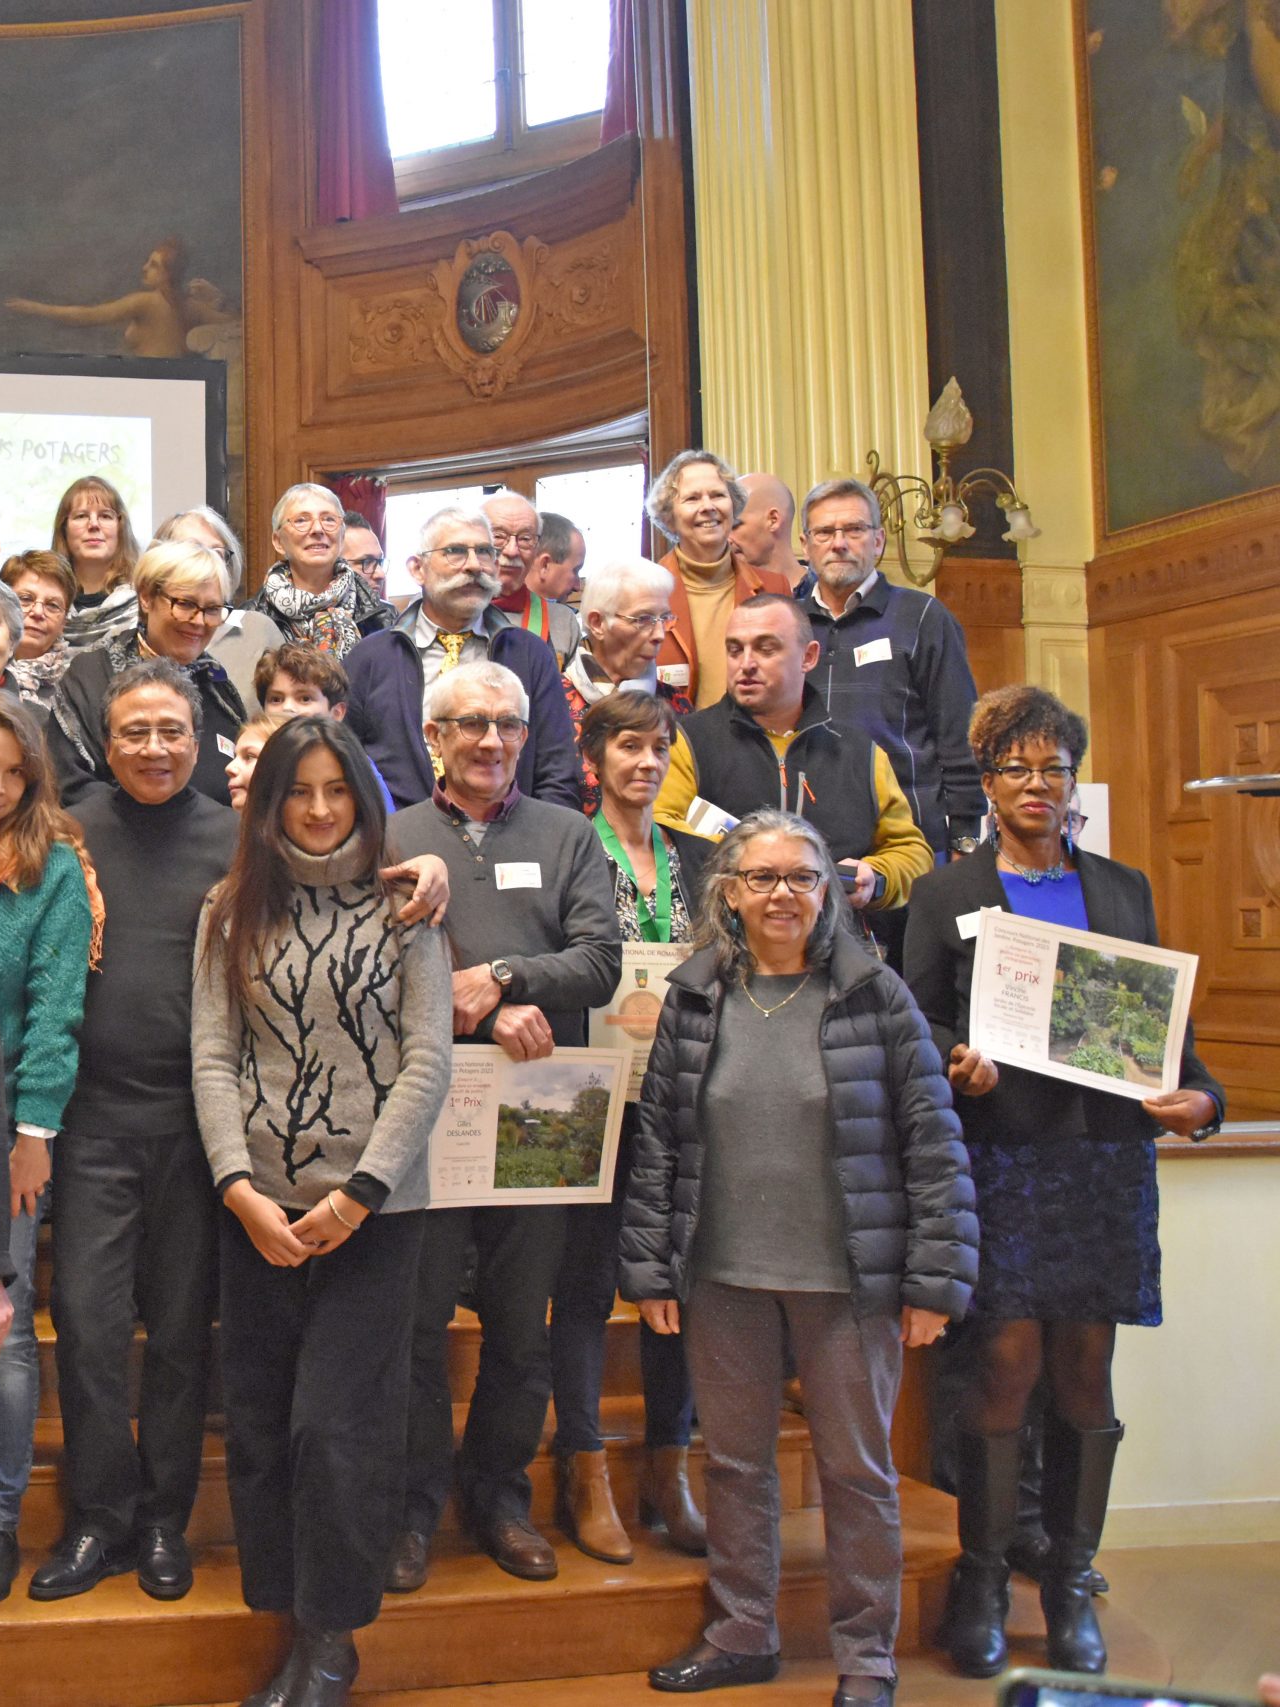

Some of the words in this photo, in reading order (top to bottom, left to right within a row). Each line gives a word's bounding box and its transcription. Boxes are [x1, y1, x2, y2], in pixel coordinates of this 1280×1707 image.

[21, 438, 121, 465] POTAGERS
[1014, 970, 1040, 984] prix
[463, 1096, 482, 1107] Prix
[446, 1129, 482, 1137] DESLANDES
